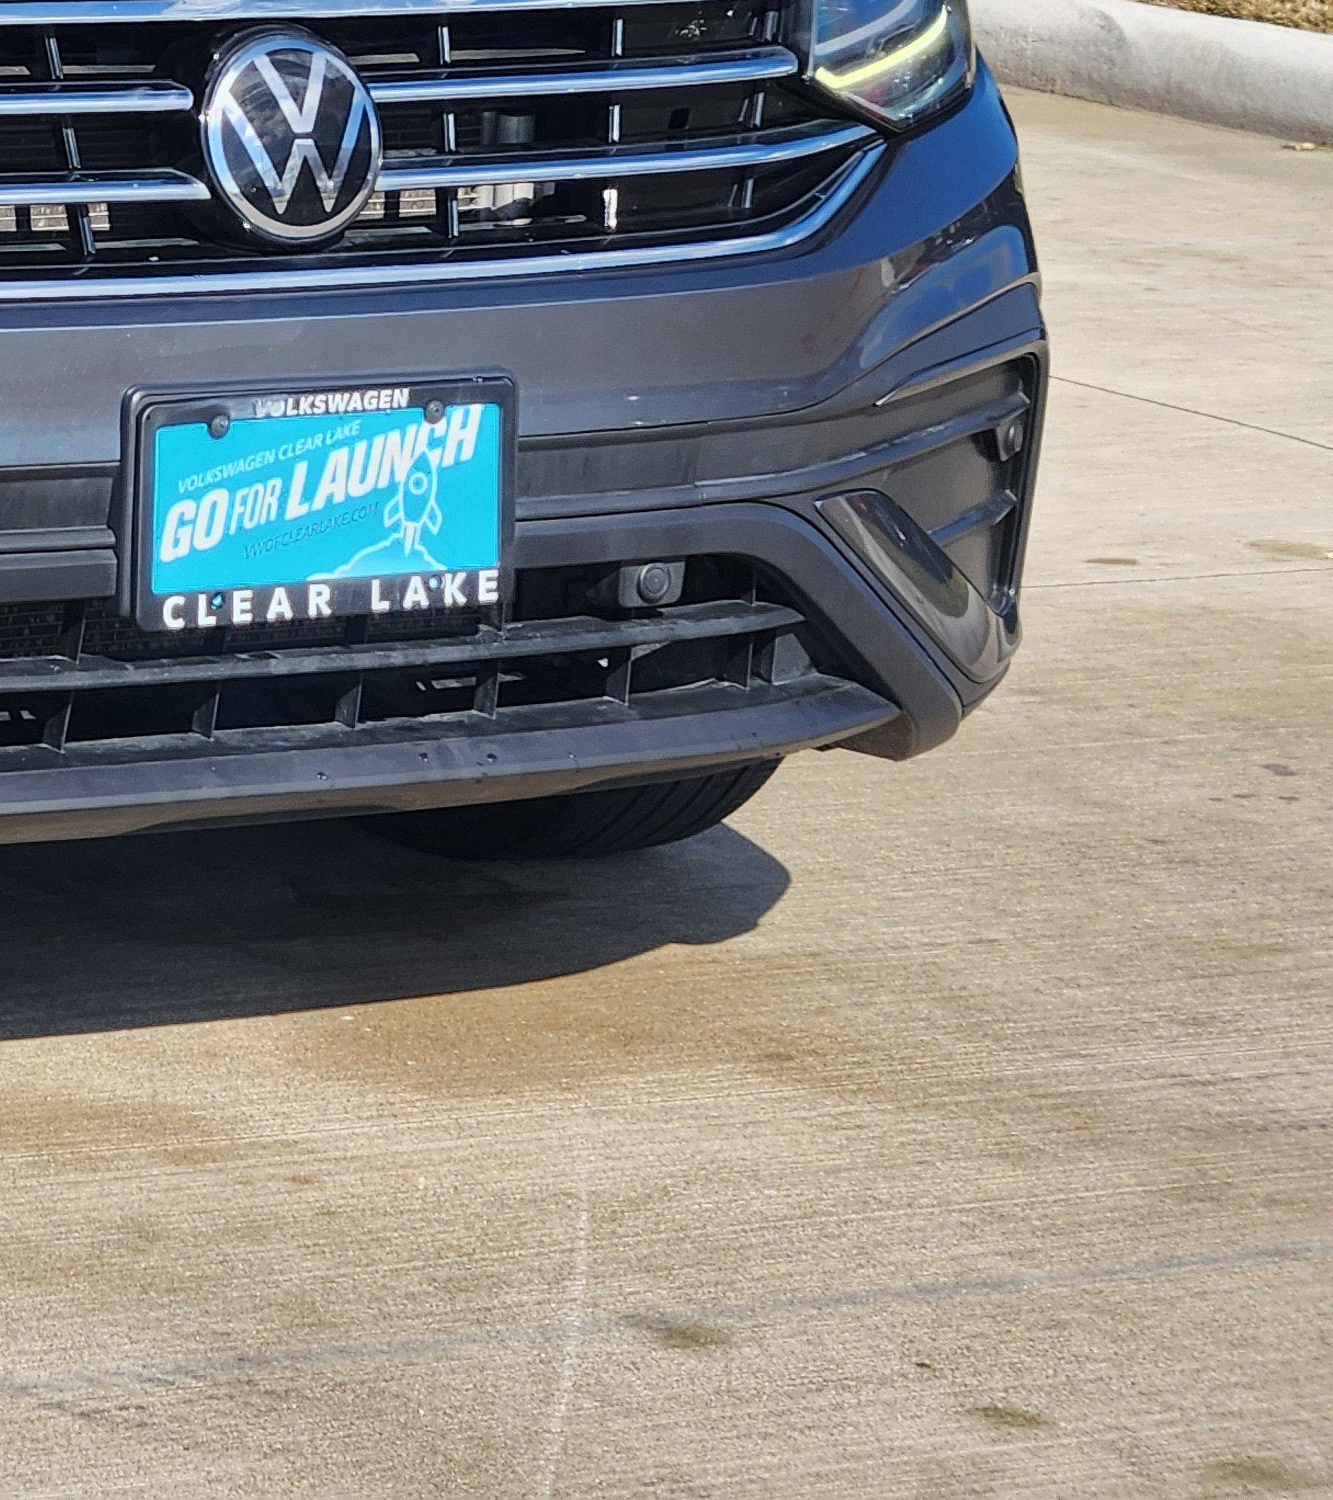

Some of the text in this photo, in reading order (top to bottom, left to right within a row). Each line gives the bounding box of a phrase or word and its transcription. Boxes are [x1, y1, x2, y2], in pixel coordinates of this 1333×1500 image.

[255, 388, 410, 418] VOLKSWAGEN
[160, 404, 483, 562] GO FOR LAUNCH
[178, 420, 362, 494] VOLKSWAGEN CLEAR LAKE
[244, 502, 380, 560] VWOFCLEARLAKE.COM
[162, 570, 500, 630] CLEAR LAKE
